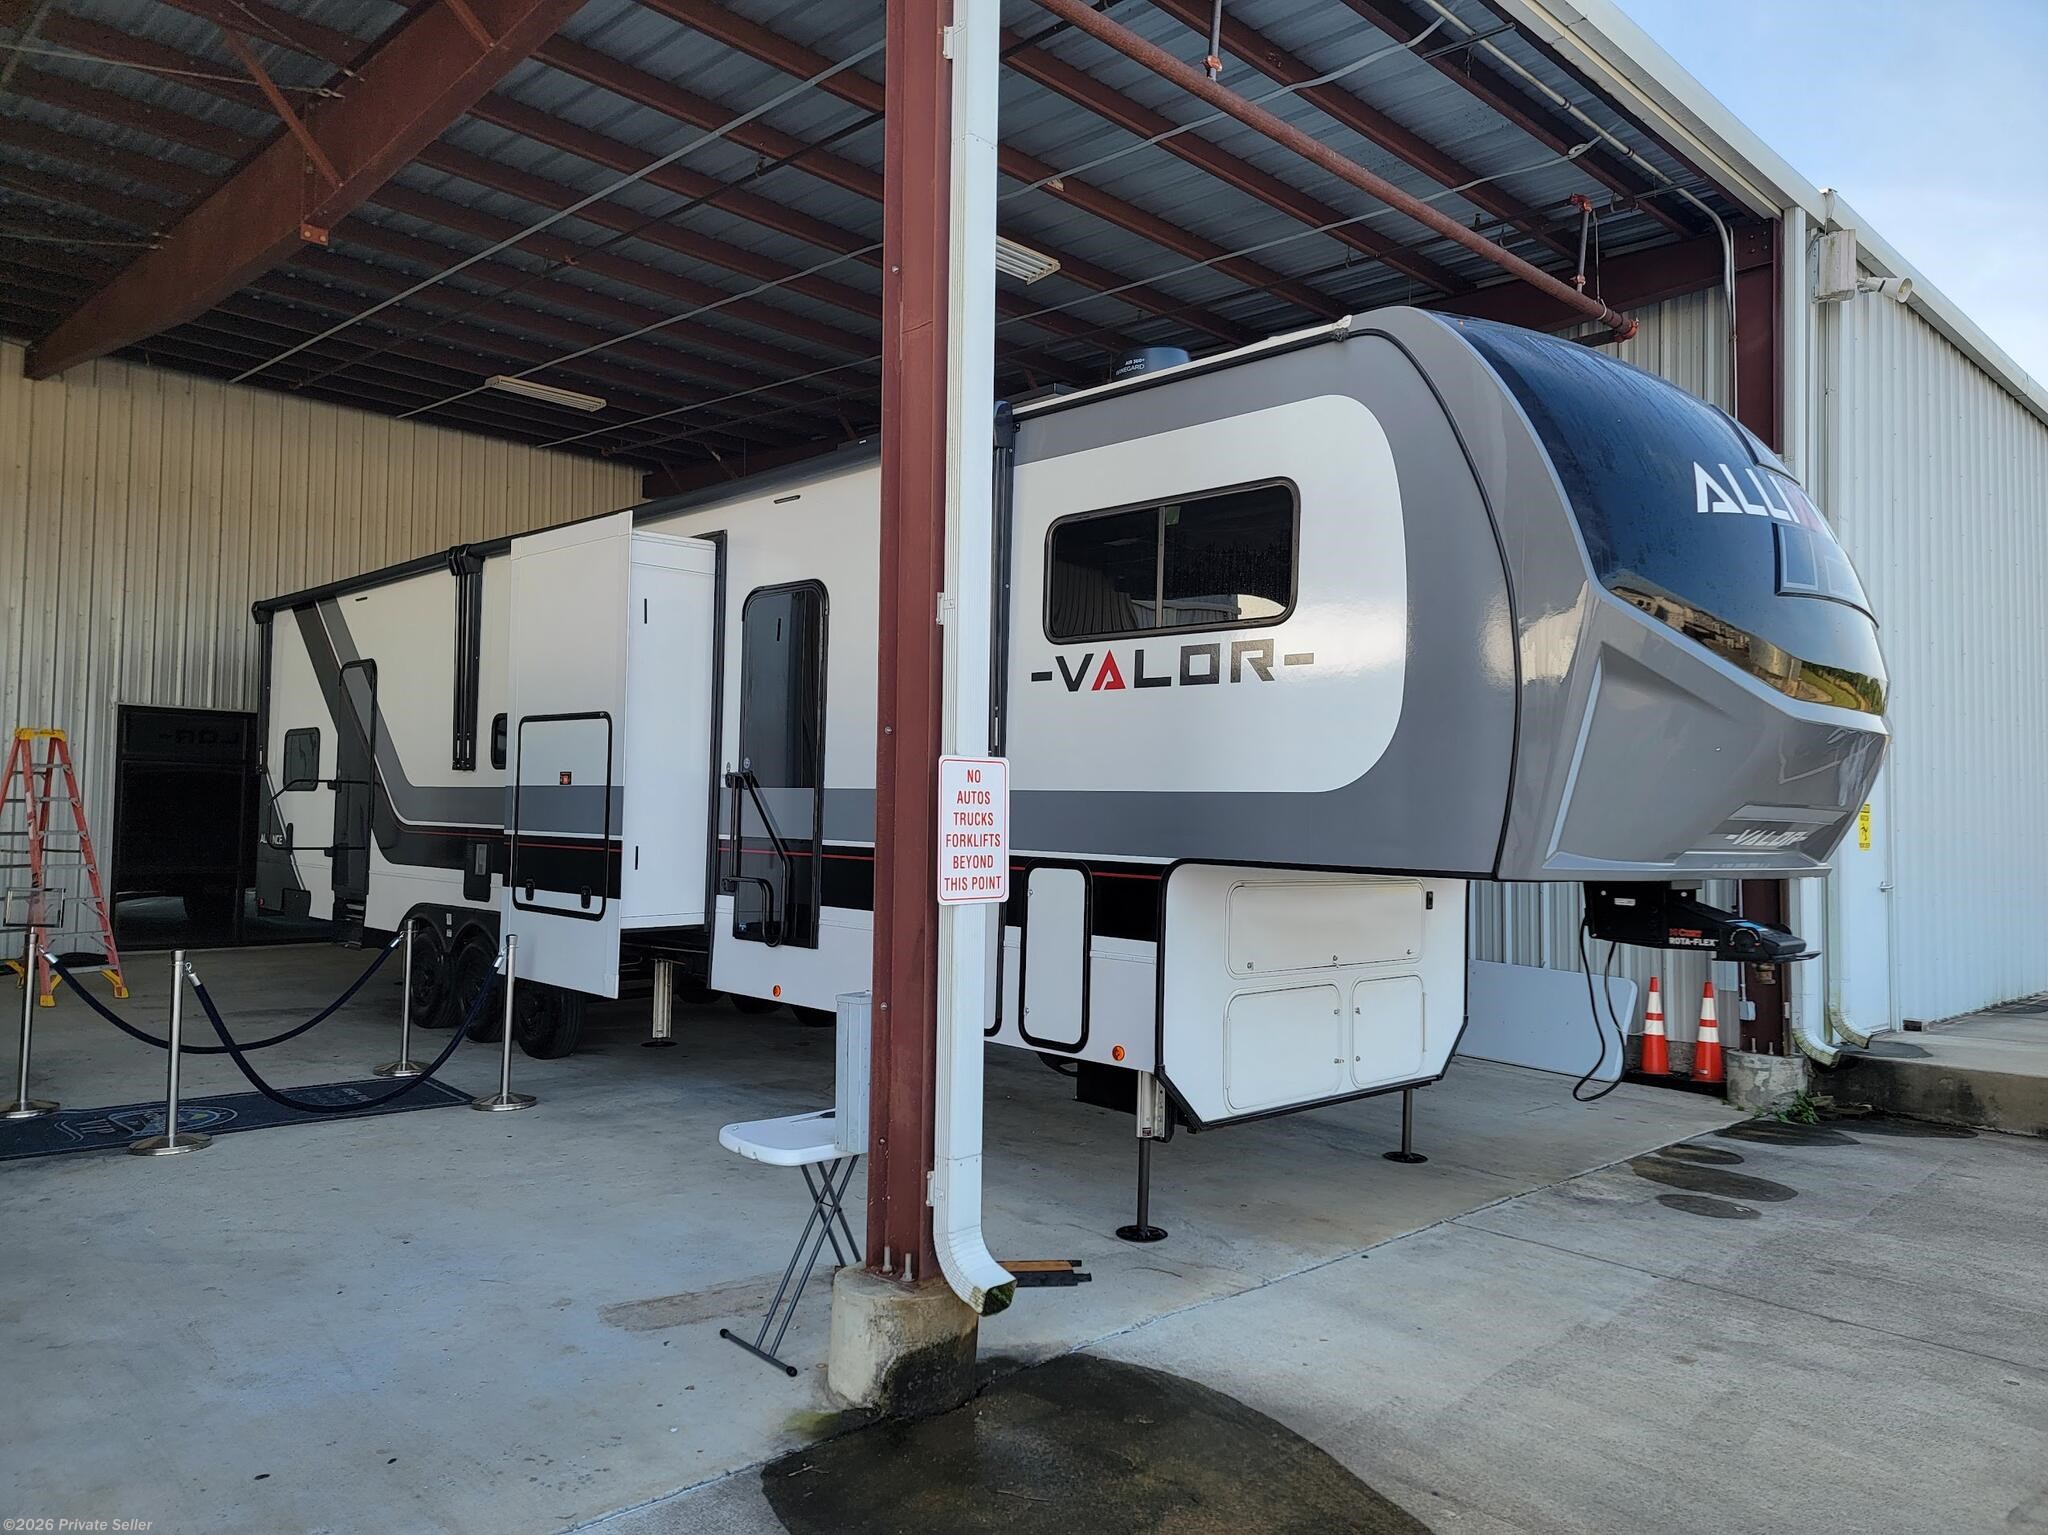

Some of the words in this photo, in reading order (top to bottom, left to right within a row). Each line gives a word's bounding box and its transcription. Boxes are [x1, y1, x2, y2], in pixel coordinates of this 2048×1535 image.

[967, 769, 981, 783] NO
[956, 790, 991, 805] AUTOS
[953, 812, 994, 826] TRUCKS
[945, 833, 1001, 848] FORKLIFTS
[953, 855, 994, 869] BEYOND
[944, 877, 968, 891] THIS
[971, 875, 1002, 891] POINT
